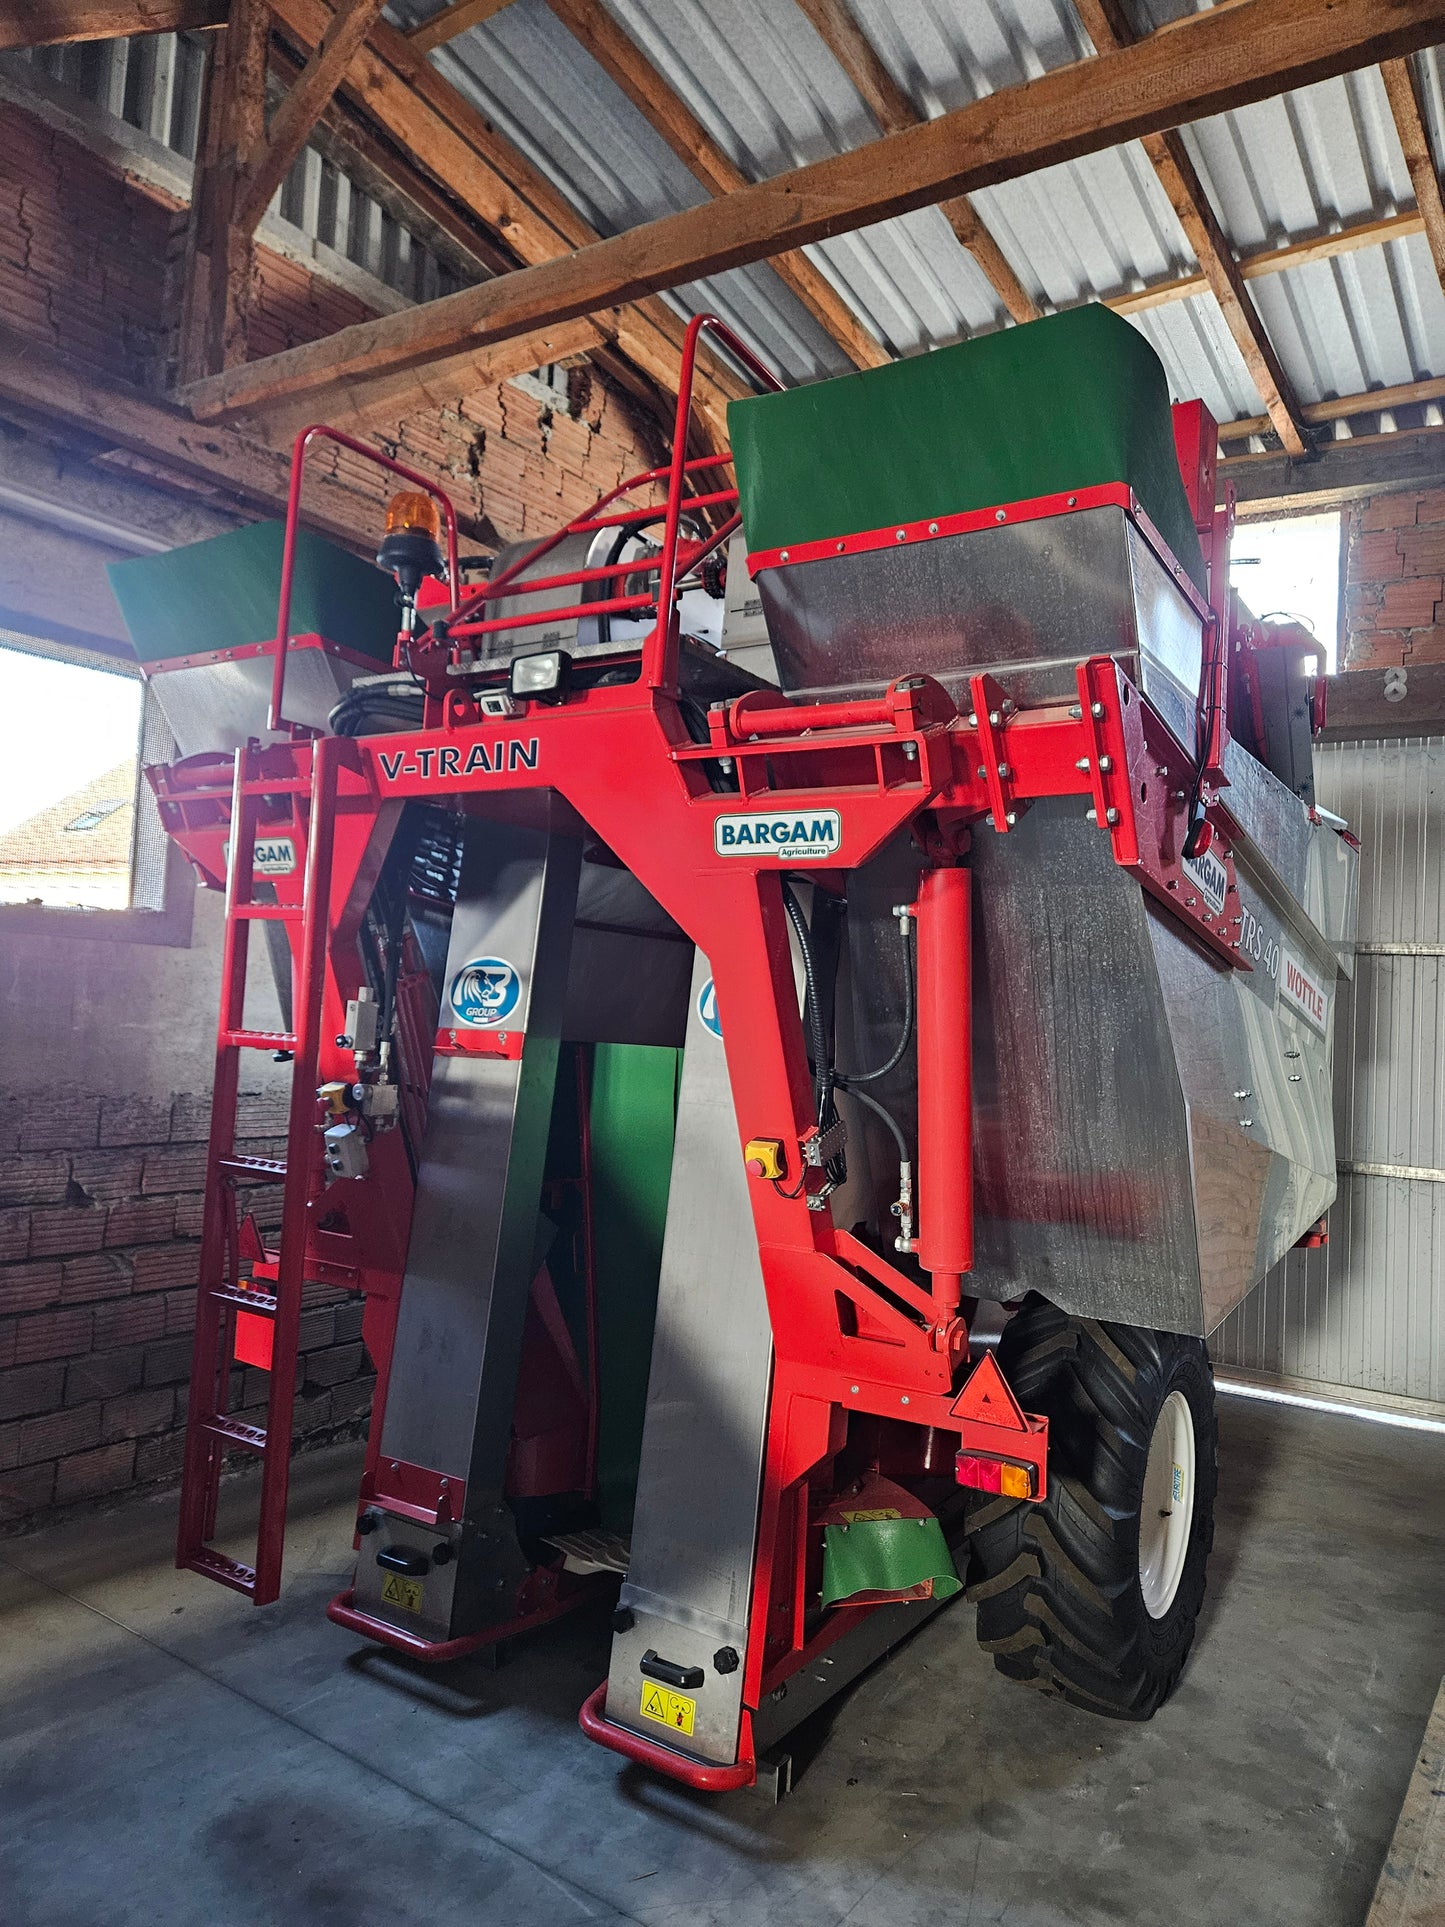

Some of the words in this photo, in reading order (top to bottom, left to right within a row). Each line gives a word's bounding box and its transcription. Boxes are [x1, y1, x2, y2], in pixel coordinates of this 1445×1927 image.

[378, 738, 539, 780] V-TRAIN
[722, 820, 834, 845] BARGAM
[781, 847, 826, 858] Agriculture
[1187, 856, 1225, 902] ARGAM
[1240, 905, 1264, 961] TRS
[1264, 938, 1279, 979] 40
[466, 1007, 497, 1017] GROUP
[1287, 960, 1323, 1022] WOTTLE
